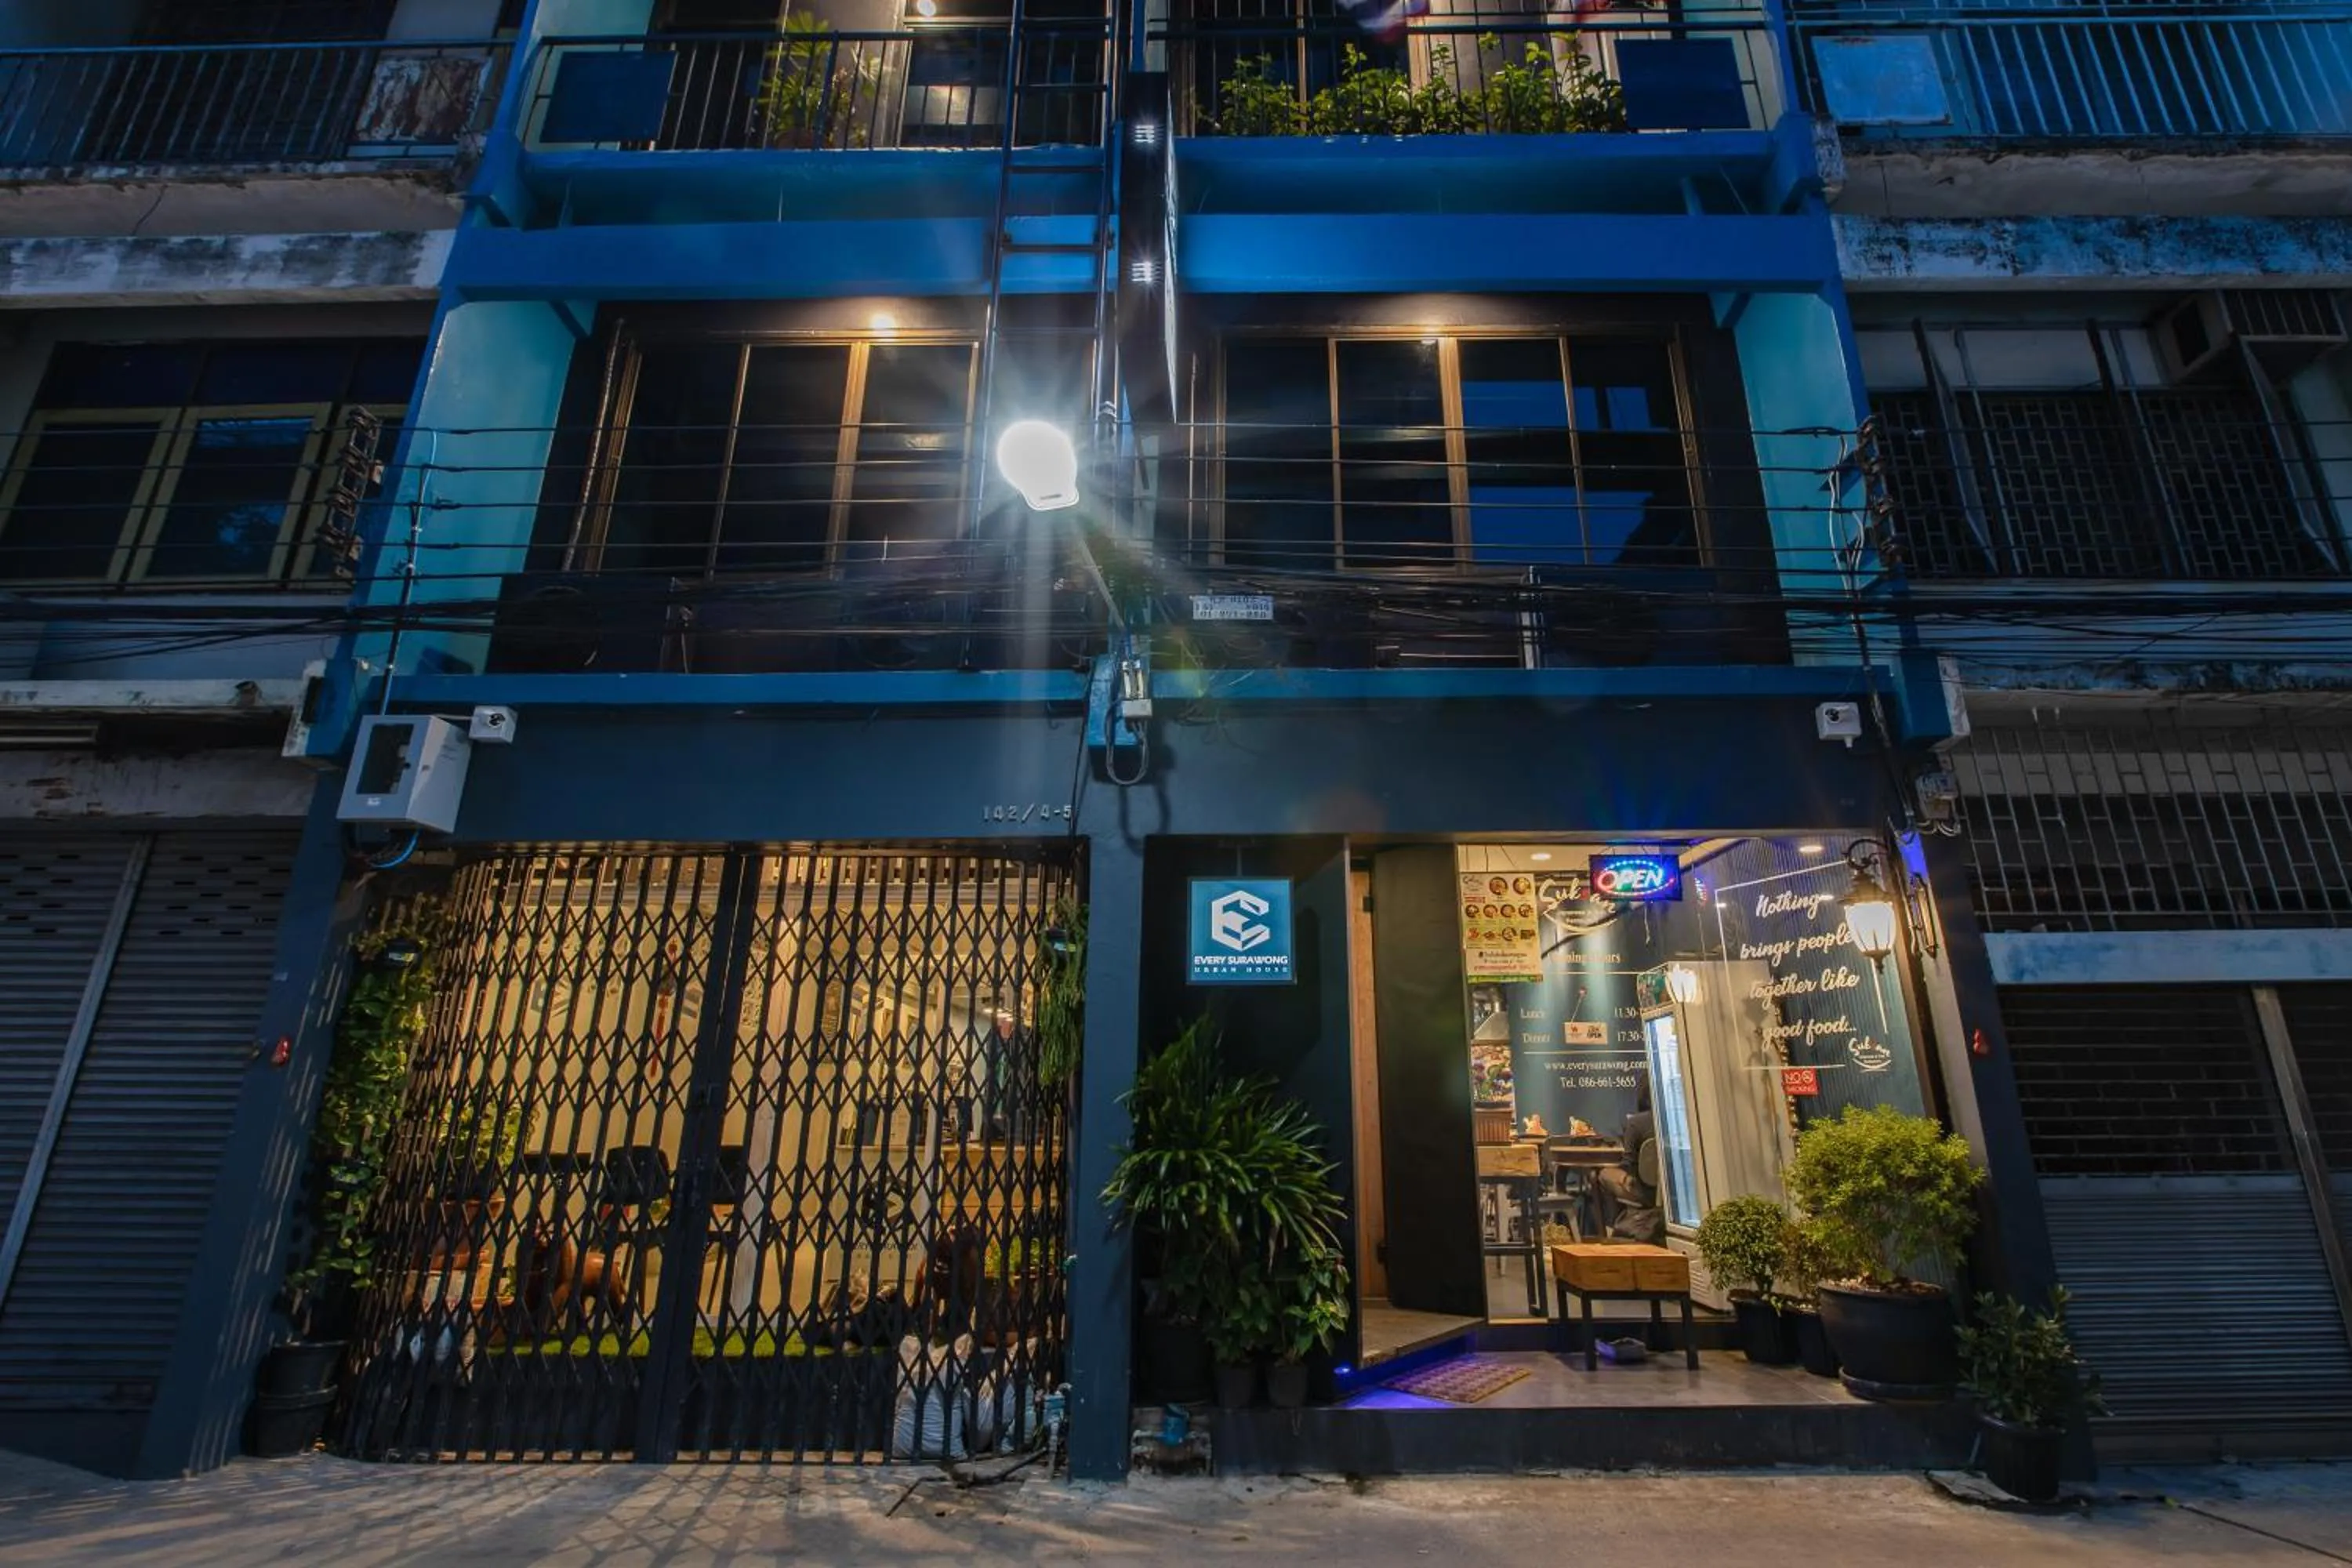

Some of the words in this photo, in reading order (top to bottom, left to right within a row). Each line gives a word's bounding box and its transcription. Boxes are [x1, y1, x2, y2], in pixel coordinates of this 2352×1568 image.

[983, 803, 1072, 821] 142/4-5
[1598, 867, 1663, 891] OPEN
[1755, 890, 1820, 920] Nothing
[1740, 943, 1793, 967] brings
[1797, 921, 1853, 957] people
[1194, 956, 1226, 964] EVERY
[1228, 956, 1288, 964] SURAWONG
[1749, 972, 1816, 1010] together
[1820, 966, 1860, 991] like
[1762, 1018, 1804, 1052] good
[1560, 1076, 1577, 1088] Tel.
[1784, 1072, 1801, 1083] NO
